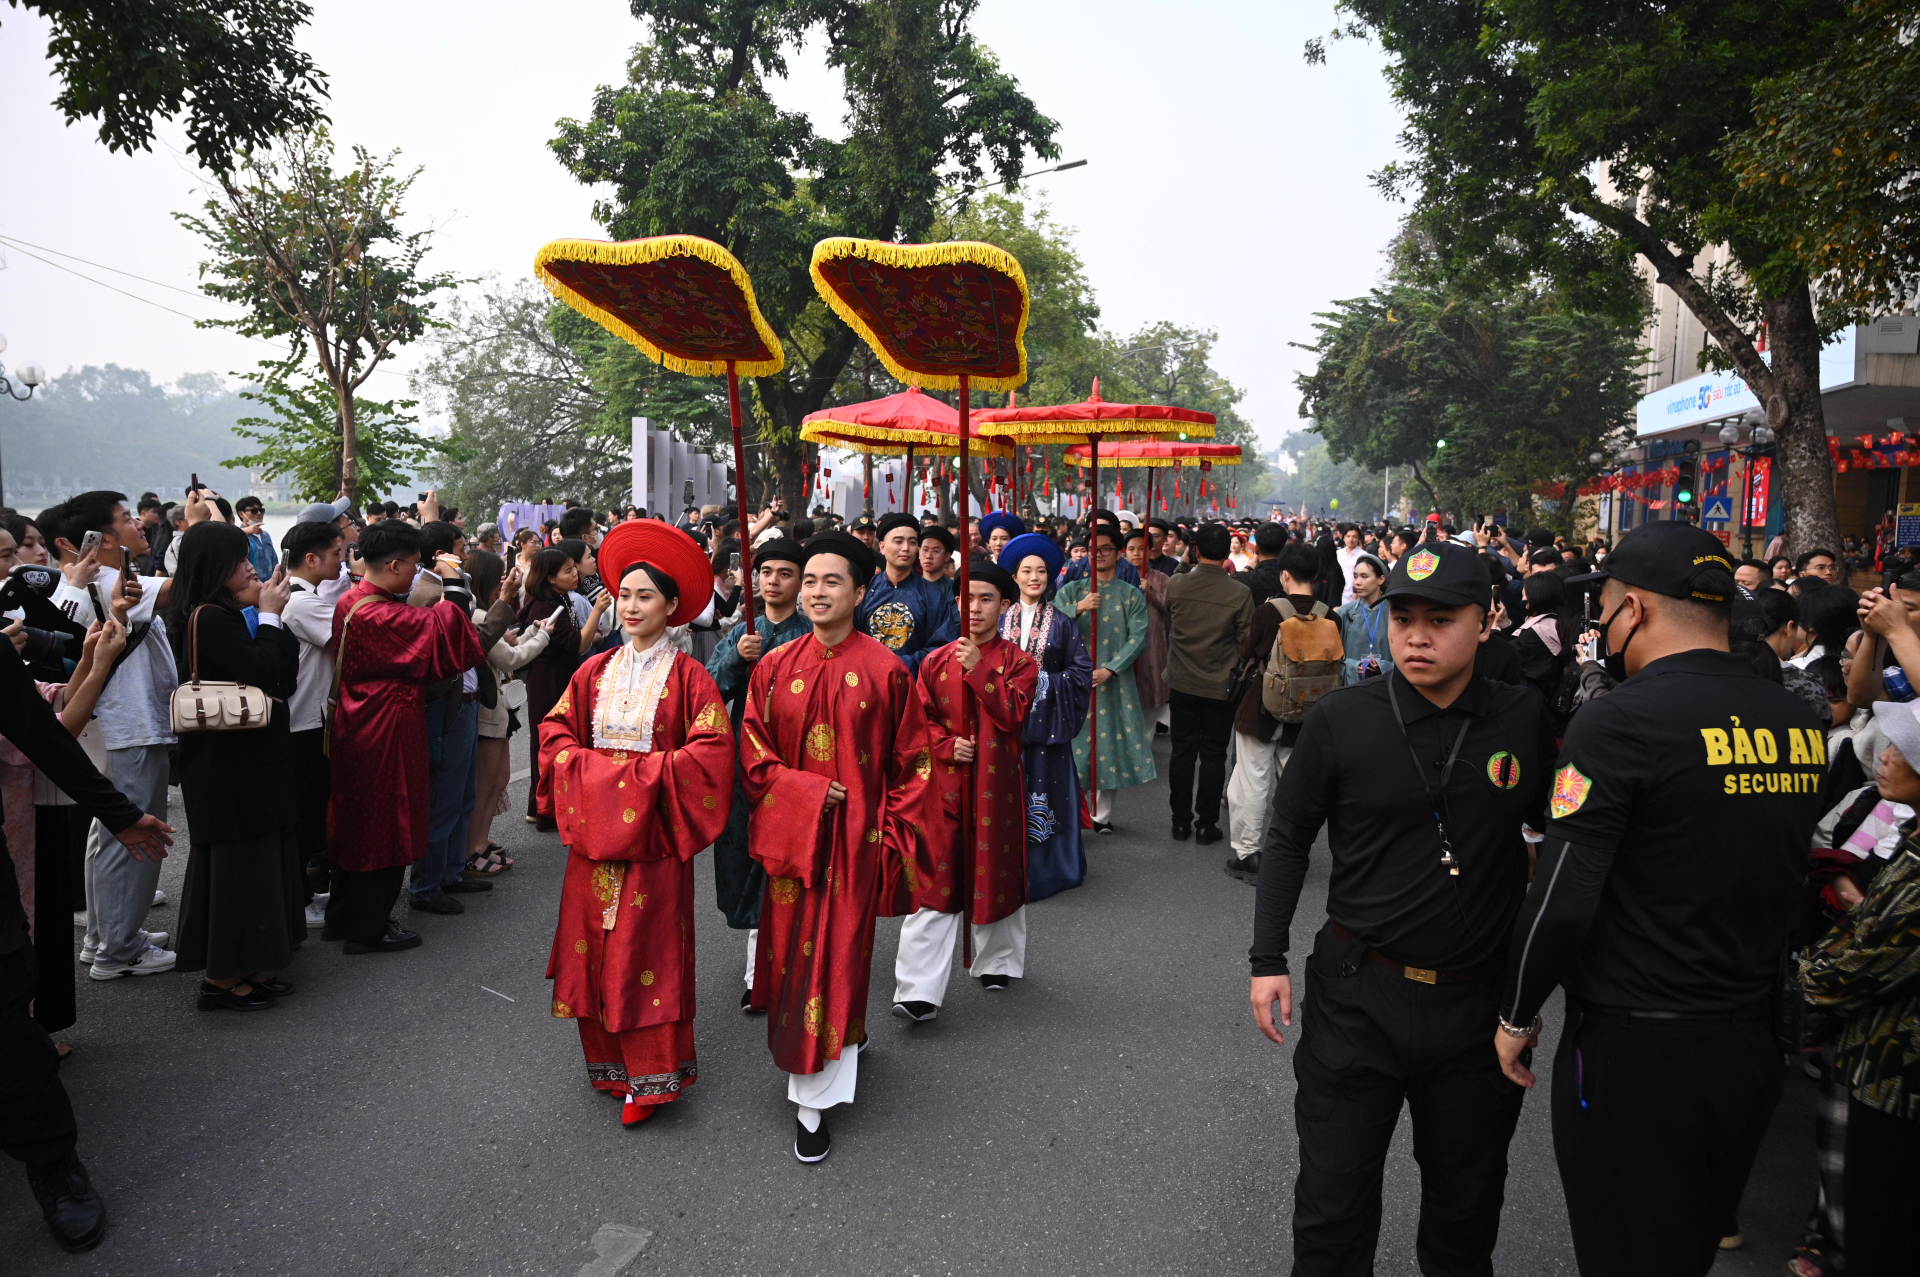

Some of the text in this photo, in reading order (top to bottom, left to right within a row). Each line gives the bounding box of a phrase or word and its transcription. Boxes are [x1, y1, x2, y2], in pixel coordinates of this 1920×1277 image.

[1667, 395, 1697, 415] vinaphone
[1700, 715, 1825, 766] BẢO AN
[1724, 773, 1819, 794] SECURITY
